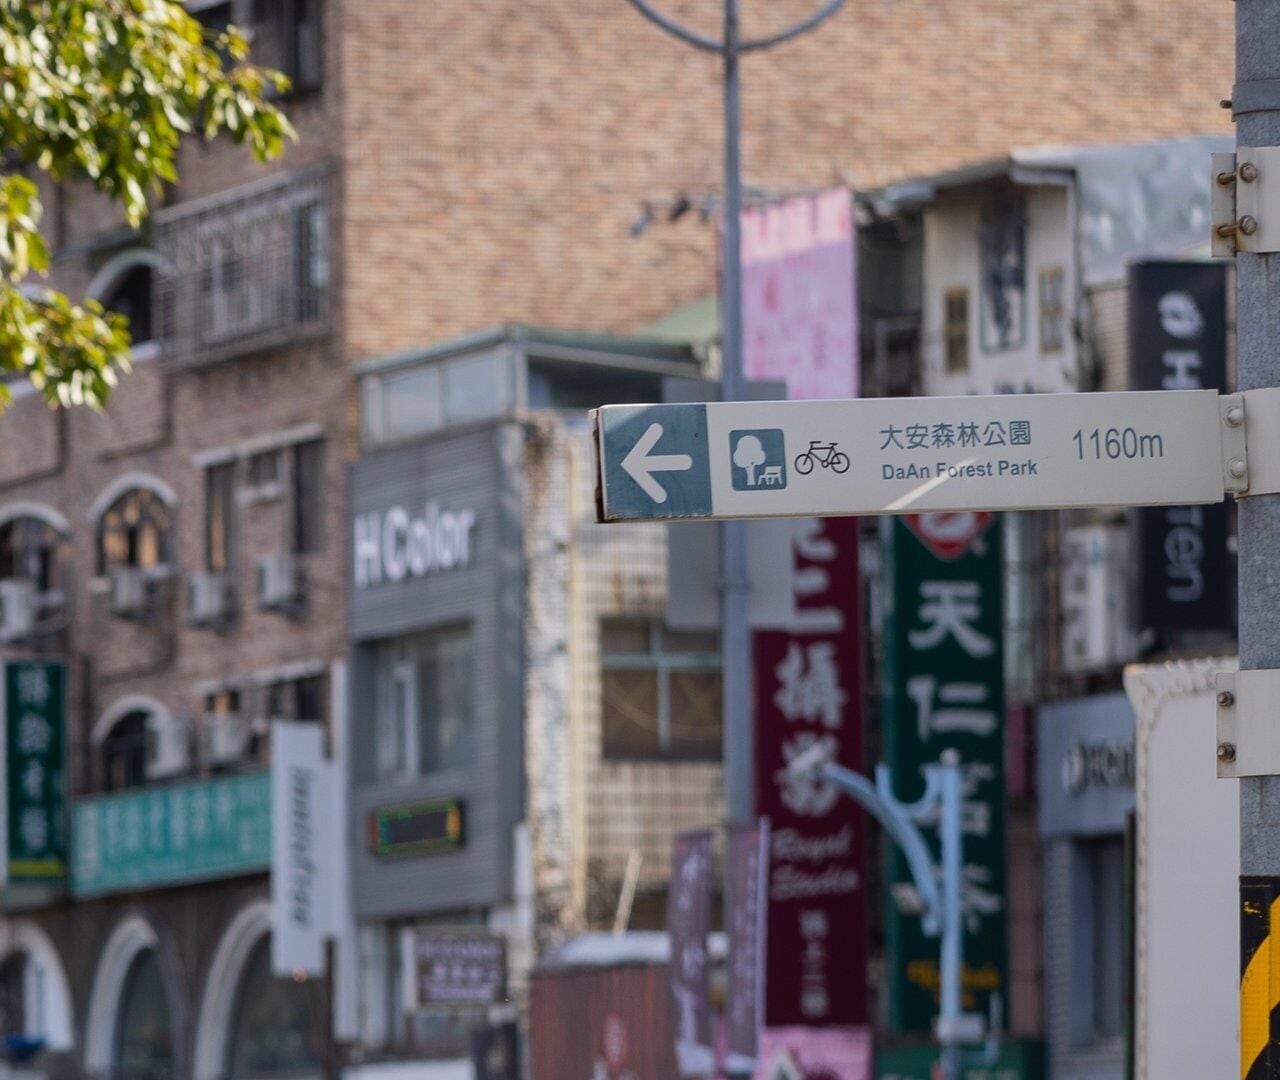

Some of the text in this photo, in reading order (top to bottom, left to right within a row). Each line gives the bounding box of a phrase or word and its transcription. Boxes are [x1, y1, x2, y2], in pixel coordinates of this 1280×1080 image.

[879, 421, 1031, 449] 大安森林公園
[1072, 426, 1164, 460] 1160m
[882, 460, 1038, 480] DaAn Forest Park
